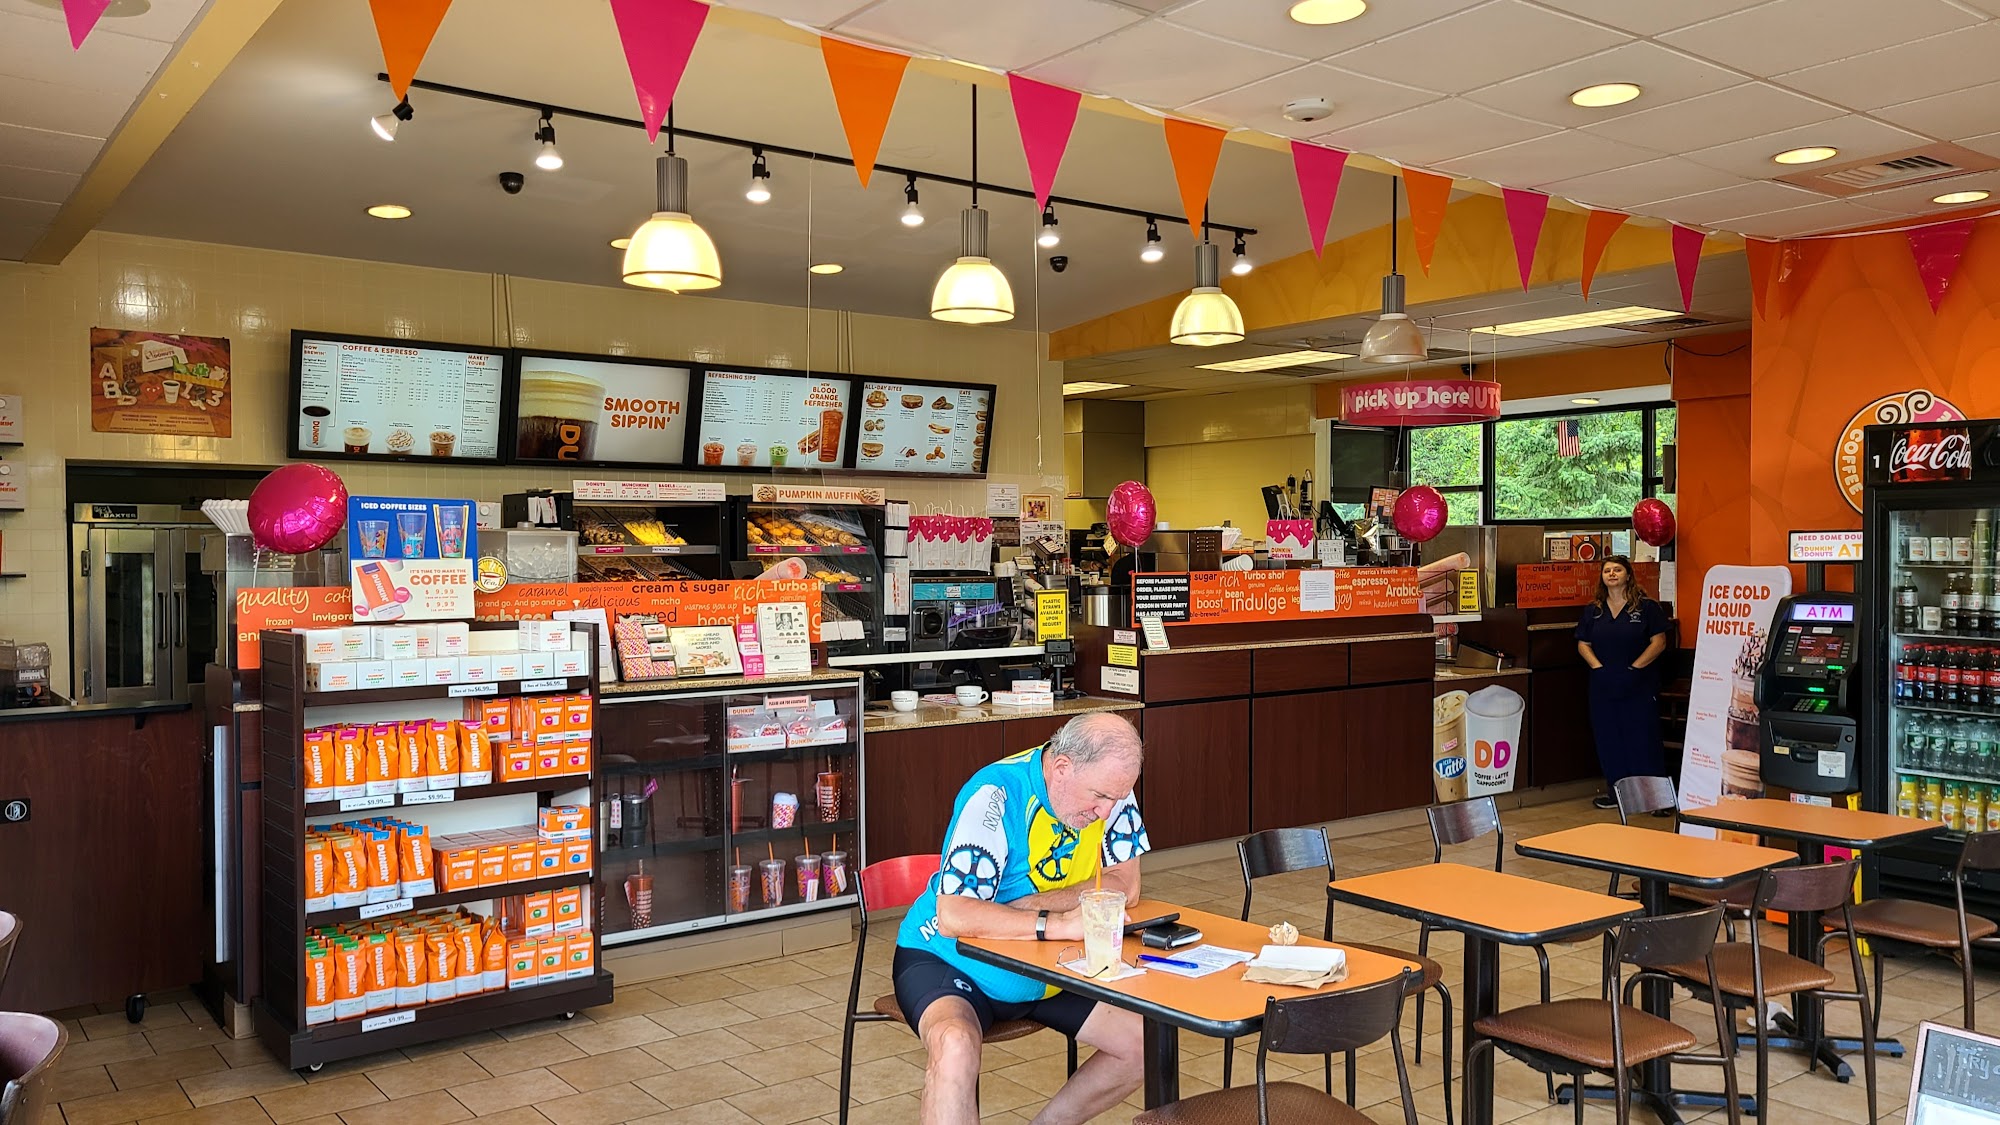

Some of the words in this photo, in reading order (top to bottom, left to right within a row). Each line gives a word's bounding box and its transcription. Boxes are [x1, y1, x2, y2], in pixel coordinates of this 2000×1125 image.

[382, 348, 418, 356] ESPRESSO
[604, 398, 680, 414] SMOOTH
[1356, 389, 1388, 413] pick
[1395, 391, 1420, 409] up
[1428, 387, 1469, 404] here
[611, 414, 670, 429] SIPPIN'
[1873, 455, 1880, 468] 1
[1889, 434, 1972, 473] Coca-Cola
[1842, 428, 1863, 496] COFFEE
[779, 490, 822, 499] PUMPKIN
[825, 491, 860, 500] MUFFIN
[410, 575, 466, 585] COFFEE
[1194, 574, 1217, 582] sugar
[1219, 572, 1240, 587] rich
[1243, 571, 1265, 580] Turbo
[1268, 571, 1285, 580] shot
[1352, 578, 1388, 588] espresso
[372, 574, 389, 602] DUNKIN'
[518, 584, 568, 597] caramel
[632, 584, 674, 594] cream
[680, 581, 688, 592] &
[693, 582, 730, 594] sugar
[734, 581, 766, 601] rich
[772, 580, 807, 592] Turbo
[1710, 585, 1730, 599] ICE
[1733, 585, 1770, 600] COLD
[237, 588, 309, 614] quality
[652, 597, 680, 605] mocha
[1225, 590, 1244, 598] bean
[583, 595, 640, 609] delicious
[712, 603, 726, 613] you
[728, 603, 737, 612] up
[1197, 597, 1223, 608] boost
[1232, 592, 1286, 614] indulge
[1708, 603, 1751, 618] LIQUID
[1807, 607, 1842, 618] ATM
[698, 613, 740, 626] boost
[1706, 620, 1755, 636] HUSTLE
[470, 733, 480, 769] DUNKIN'
[1474, 740, 1510, 769] DD
[311, 746, 323, 784] DUNKIN'
[1440, 758, 1464, 778] Latte
[1495, 771, 1509, 780] LATTE
[920, 915, 937, 941] Ne
[375, 946, 385, 986] DUNKIN'
